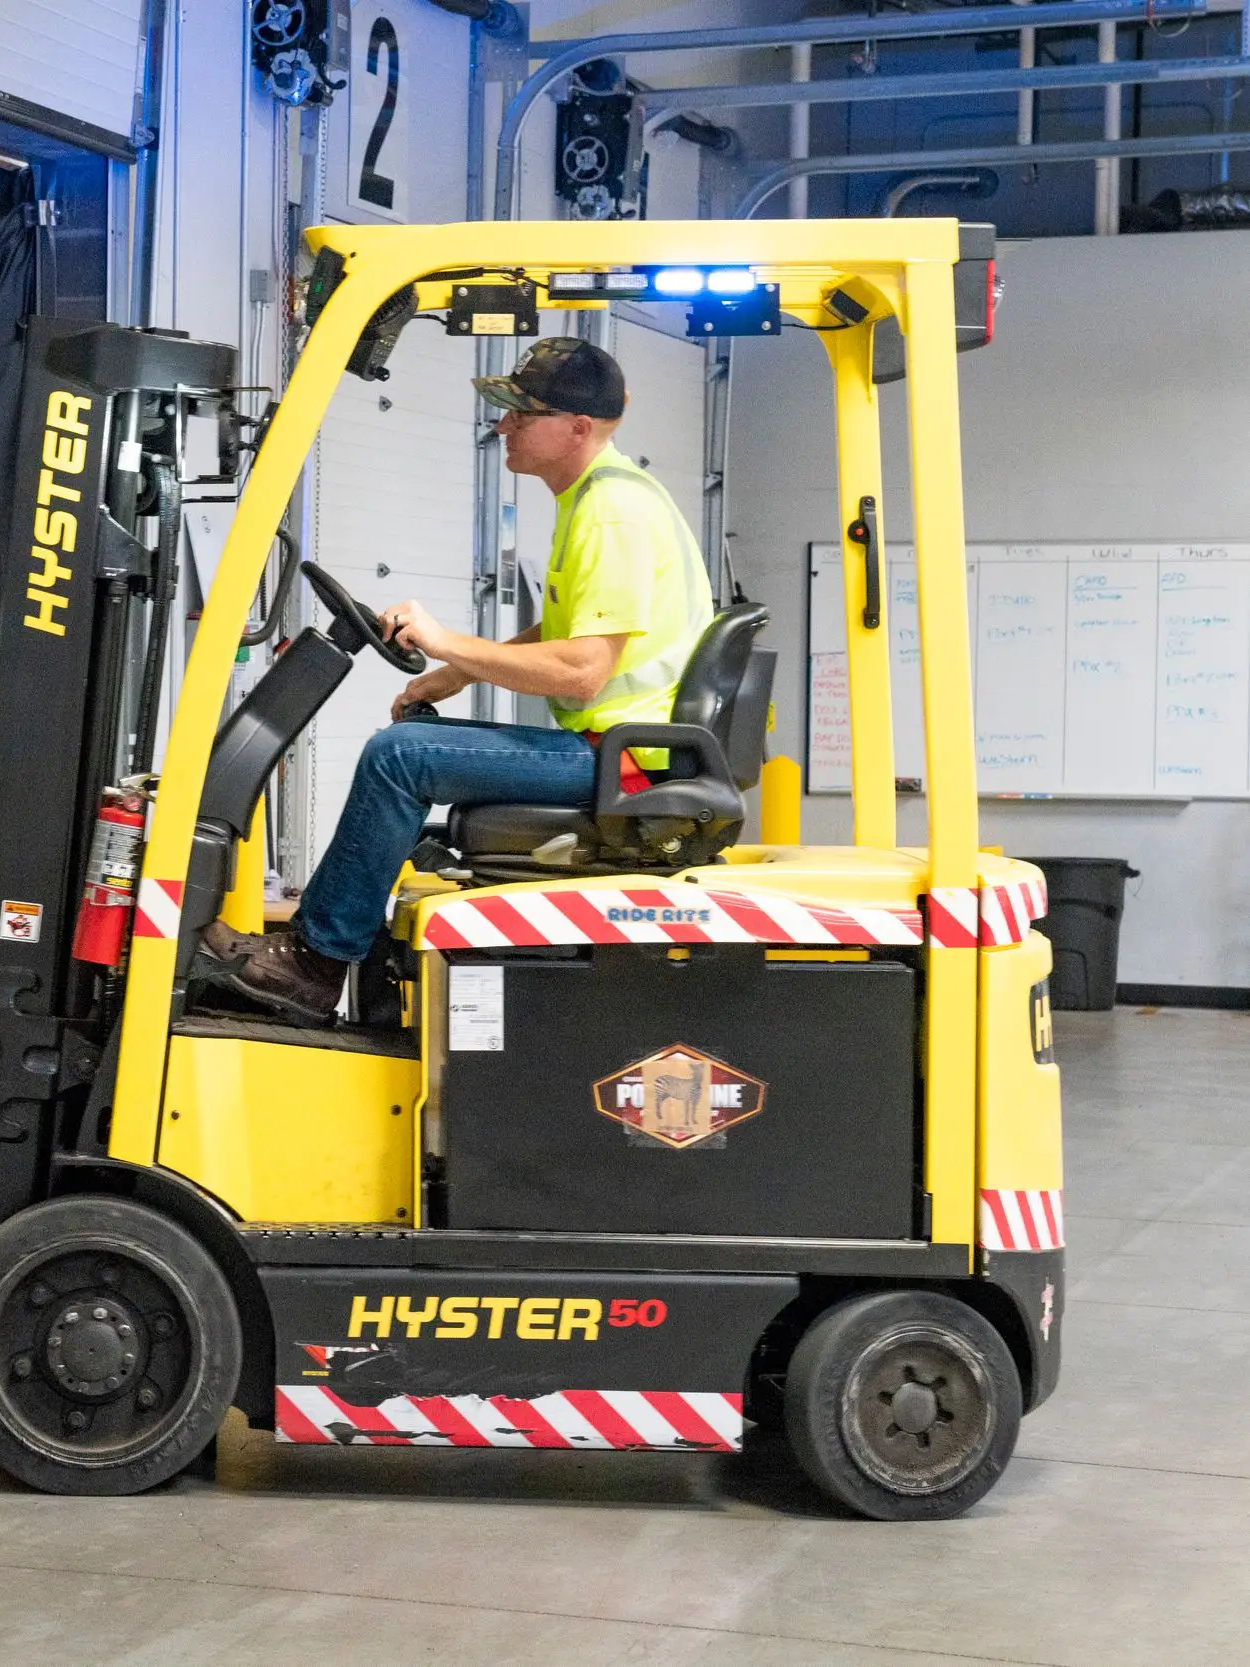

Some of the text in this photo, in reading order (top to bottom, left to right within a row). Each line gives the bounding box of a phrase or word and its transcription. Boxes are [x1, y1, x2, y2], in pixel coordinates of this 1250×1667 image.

[359, 17, 399, 210] 2
[23, 391, 92, 637] HYSTER
[347, 1295, 668, 1341] HYSTER 50
